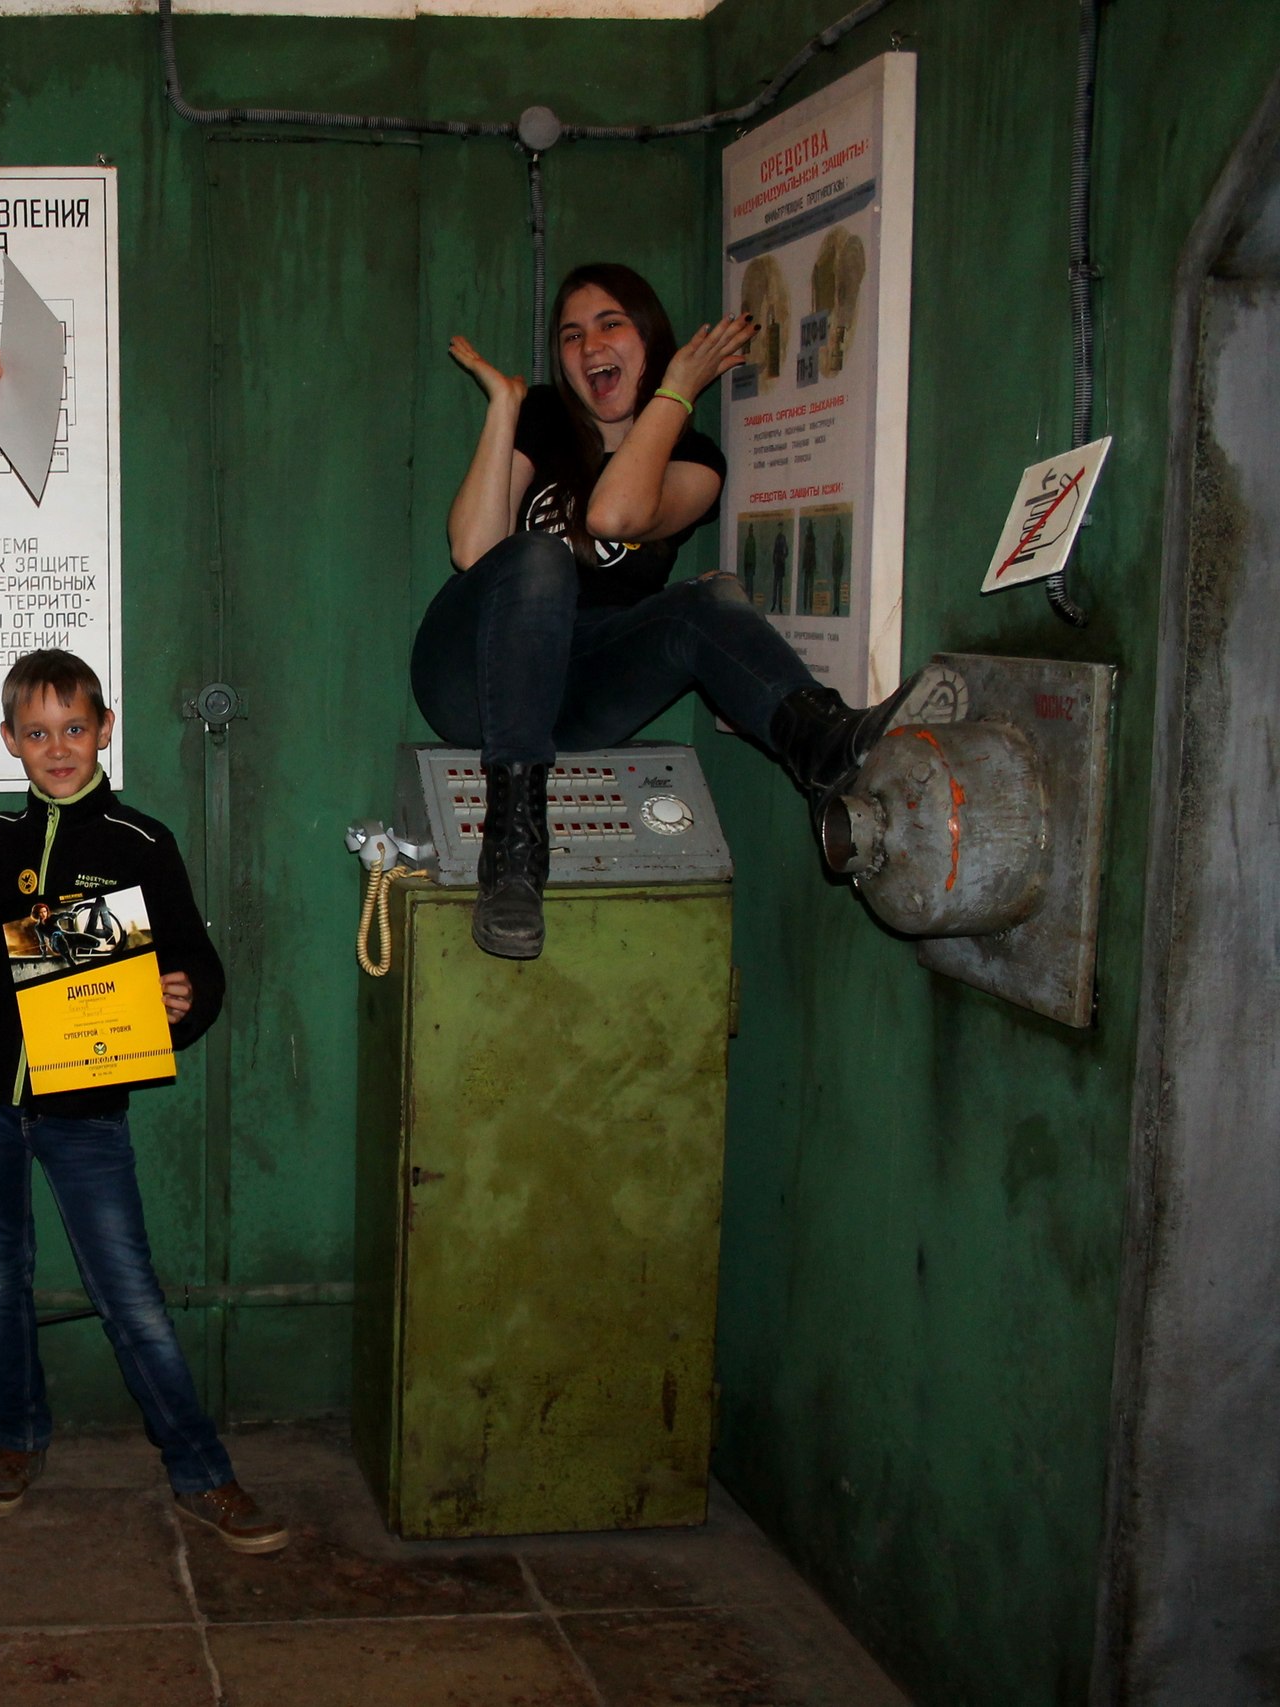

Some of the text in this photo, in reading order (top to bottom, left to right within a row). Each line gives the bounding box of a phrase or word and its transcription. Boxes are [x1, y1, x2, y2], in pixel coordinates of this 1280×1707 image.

[760, 129, 828, 183] СРЕДСТВА
[15, 555, 90, 574] ЗАЩИТЕ
[13, 612, 36, 629] ОТ
[67, 981, 116, 1001] ДИПЛОМ
[63, 1024, 132, 1041] СУПЕРГЕРОЙ УРОВНЯ
